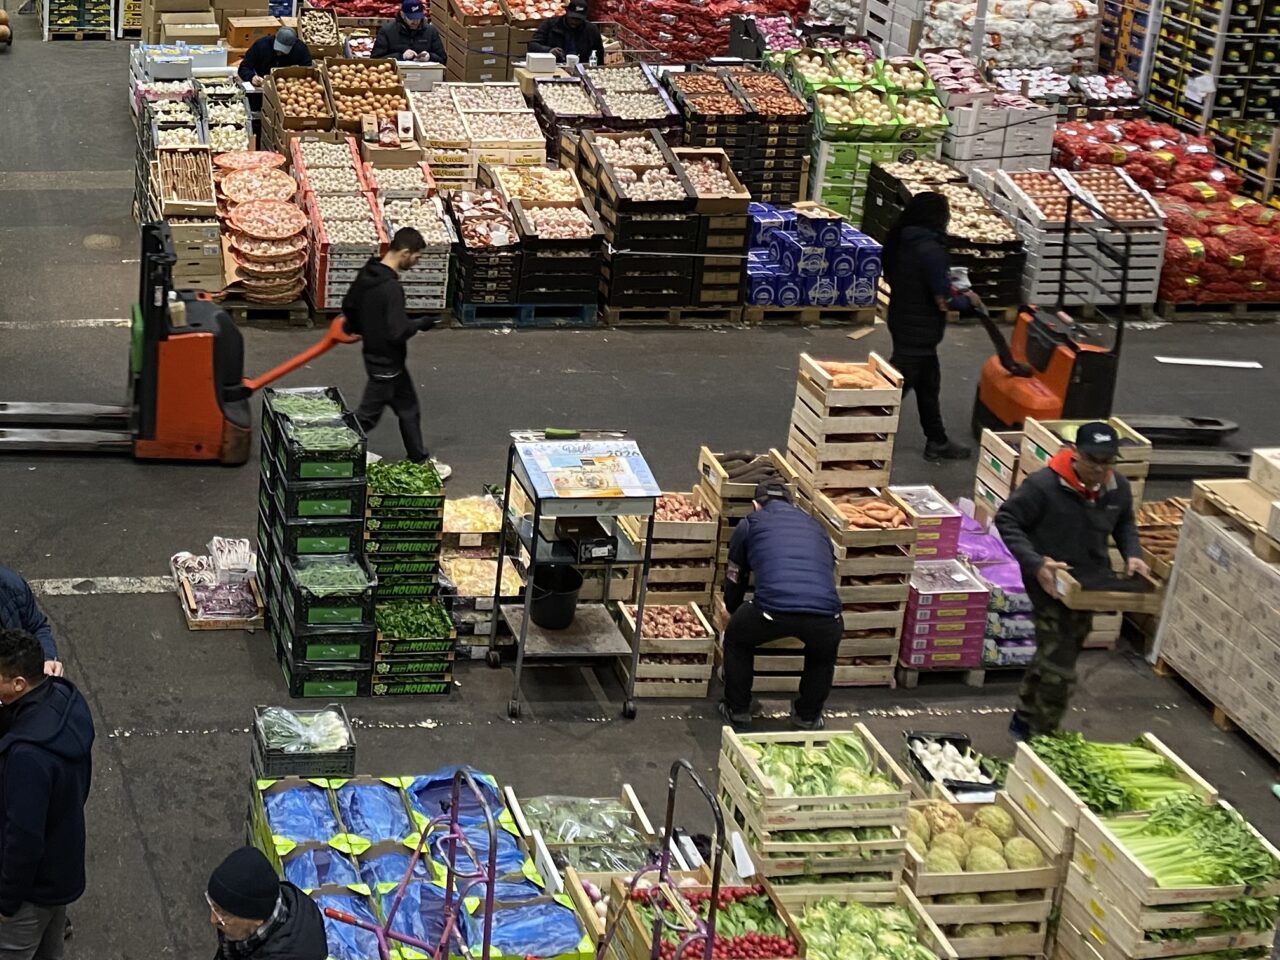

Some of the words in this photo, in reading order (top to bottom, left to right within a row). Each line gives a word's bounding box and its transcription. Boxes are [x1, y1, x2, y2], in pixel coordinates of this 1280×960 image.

[399, 498, 441, 507] NOURRIT
[397, 520, 439, 529] NOURRIT
[396, 543, 438, 551] NOURRIT
[393, 563, 435, 572] NOURRIT
[392, 585, 434, 594] NOURRIT
[410, 642, 452, 651] NOURRIT
[406, 663, 449, 672] NOURRIT
[404, 684, 447, 693] NOURRIT
